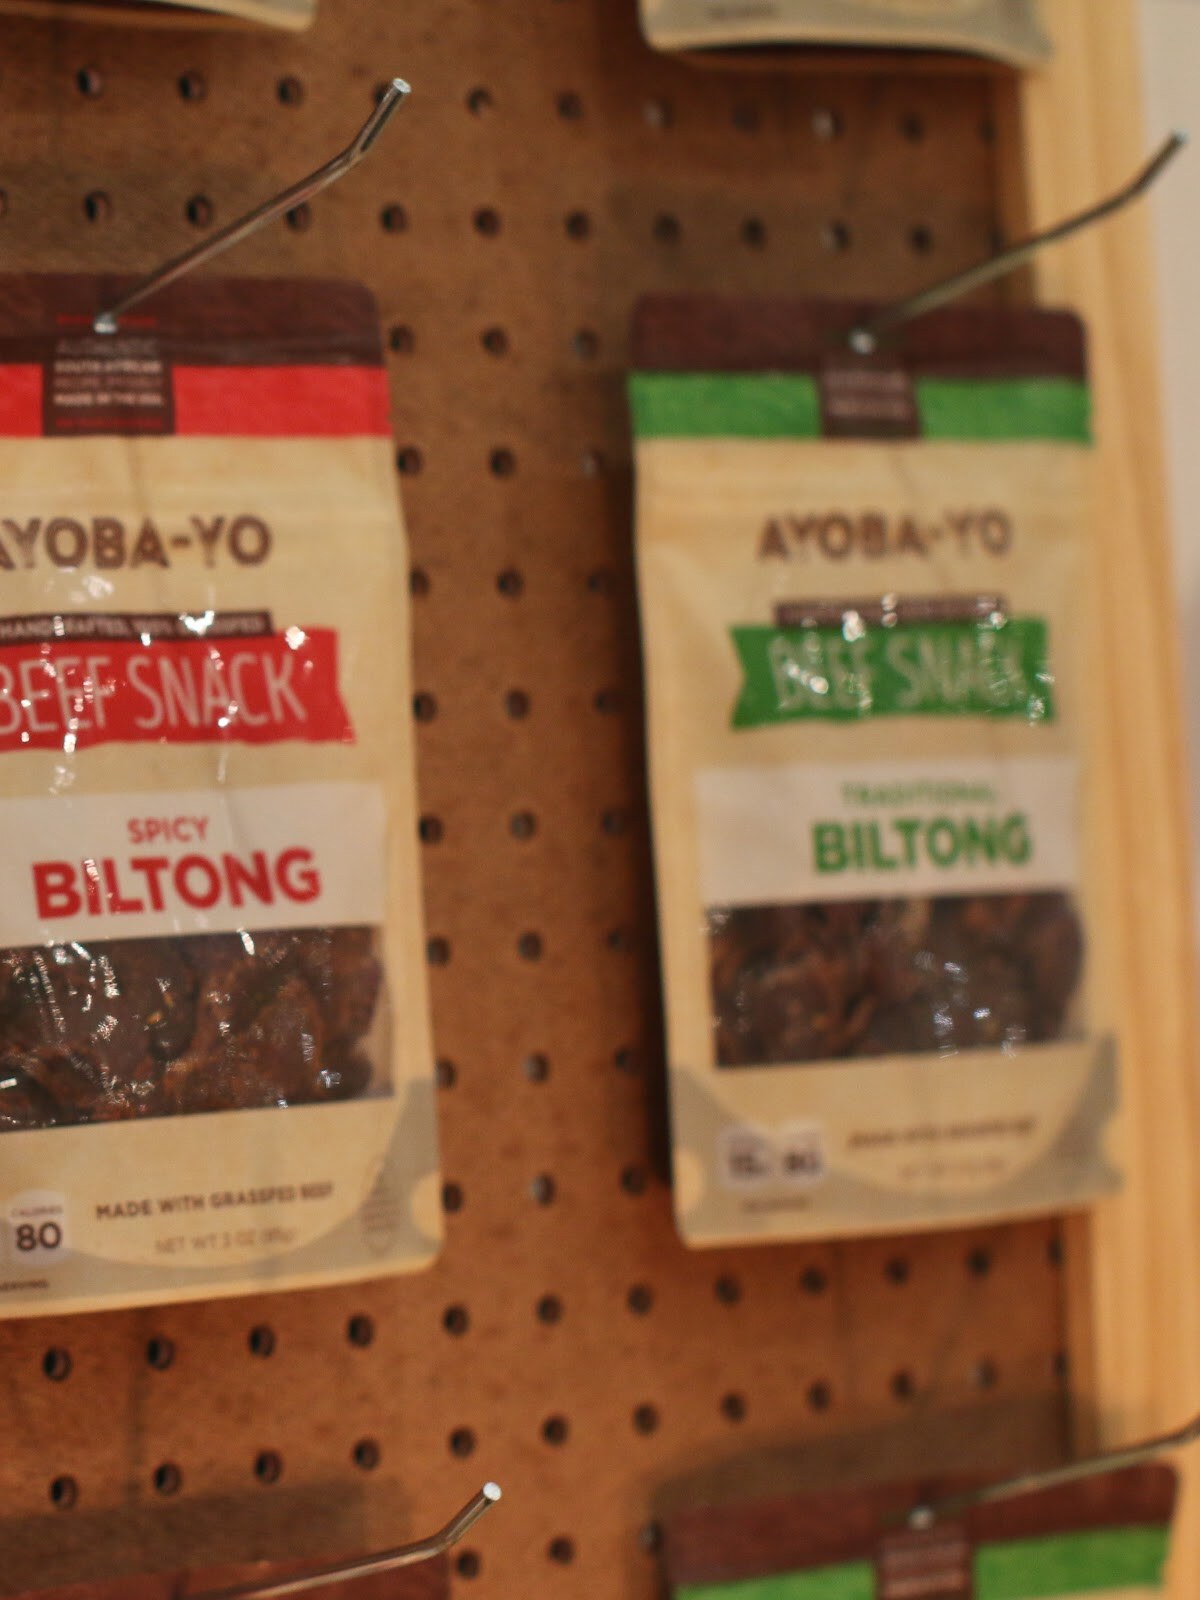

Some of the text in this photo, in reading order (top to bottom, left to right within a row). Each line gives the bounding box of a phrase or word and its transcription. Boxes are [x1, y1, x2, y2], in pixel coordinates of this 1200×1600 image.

[757, 508, 1014, 562] AYOBA-YO
[126, 653, 308, 730] SNACK
[126, 816, 210, 845] SPICY
[811, 810, 1034, 873] BILTONG
[31, 845, 323, 920] BILTONG
[96, 1199, 153, 1220] MADE
[157, 1193, 206, 1213] WITH
[15, 1221, 63, 1252] 80
